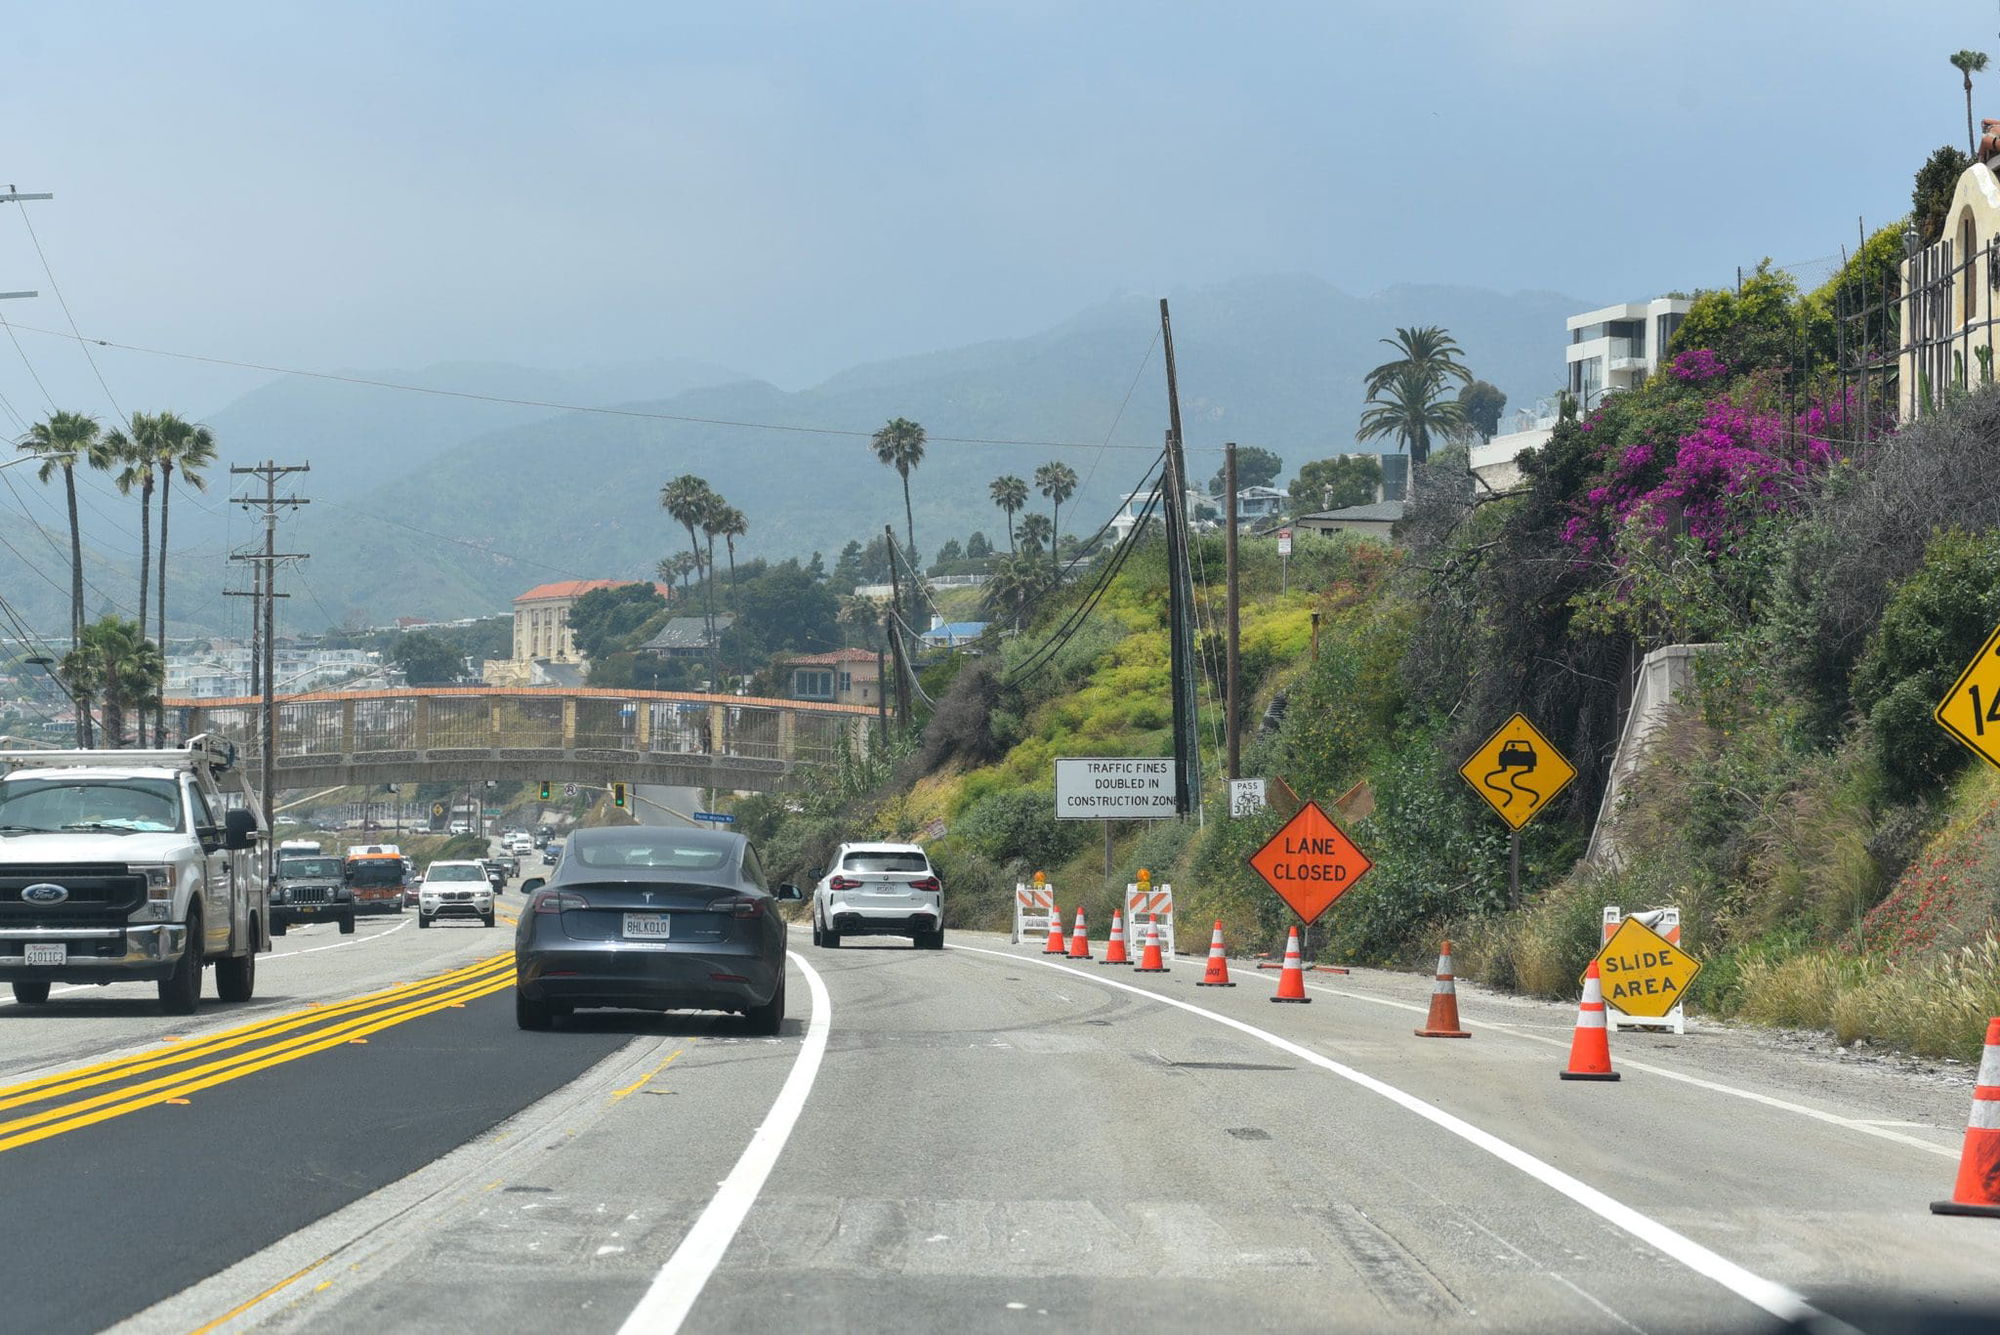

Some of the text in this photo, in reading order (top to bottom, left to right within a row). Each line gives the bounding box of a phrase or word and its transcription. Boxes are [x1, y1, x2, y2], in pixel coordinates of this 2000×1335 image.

[1087, 763, 1168, 773] TRAFFIC FINES
[1095, 778, 1159, 789] DOUBLED IN
[1237, 782, 1258, 790] PASS
[1067, 796, 1149, 806] CONSTRUCTION
[1285, 837, 1335, 855] LANE
[1273, 863, 1347, 882] CLOSED
[33, 888, 56, 899] Ford
[1606, 950, 1673, 973] SLIDE
[1613, 976, 1677, 999] AREA
